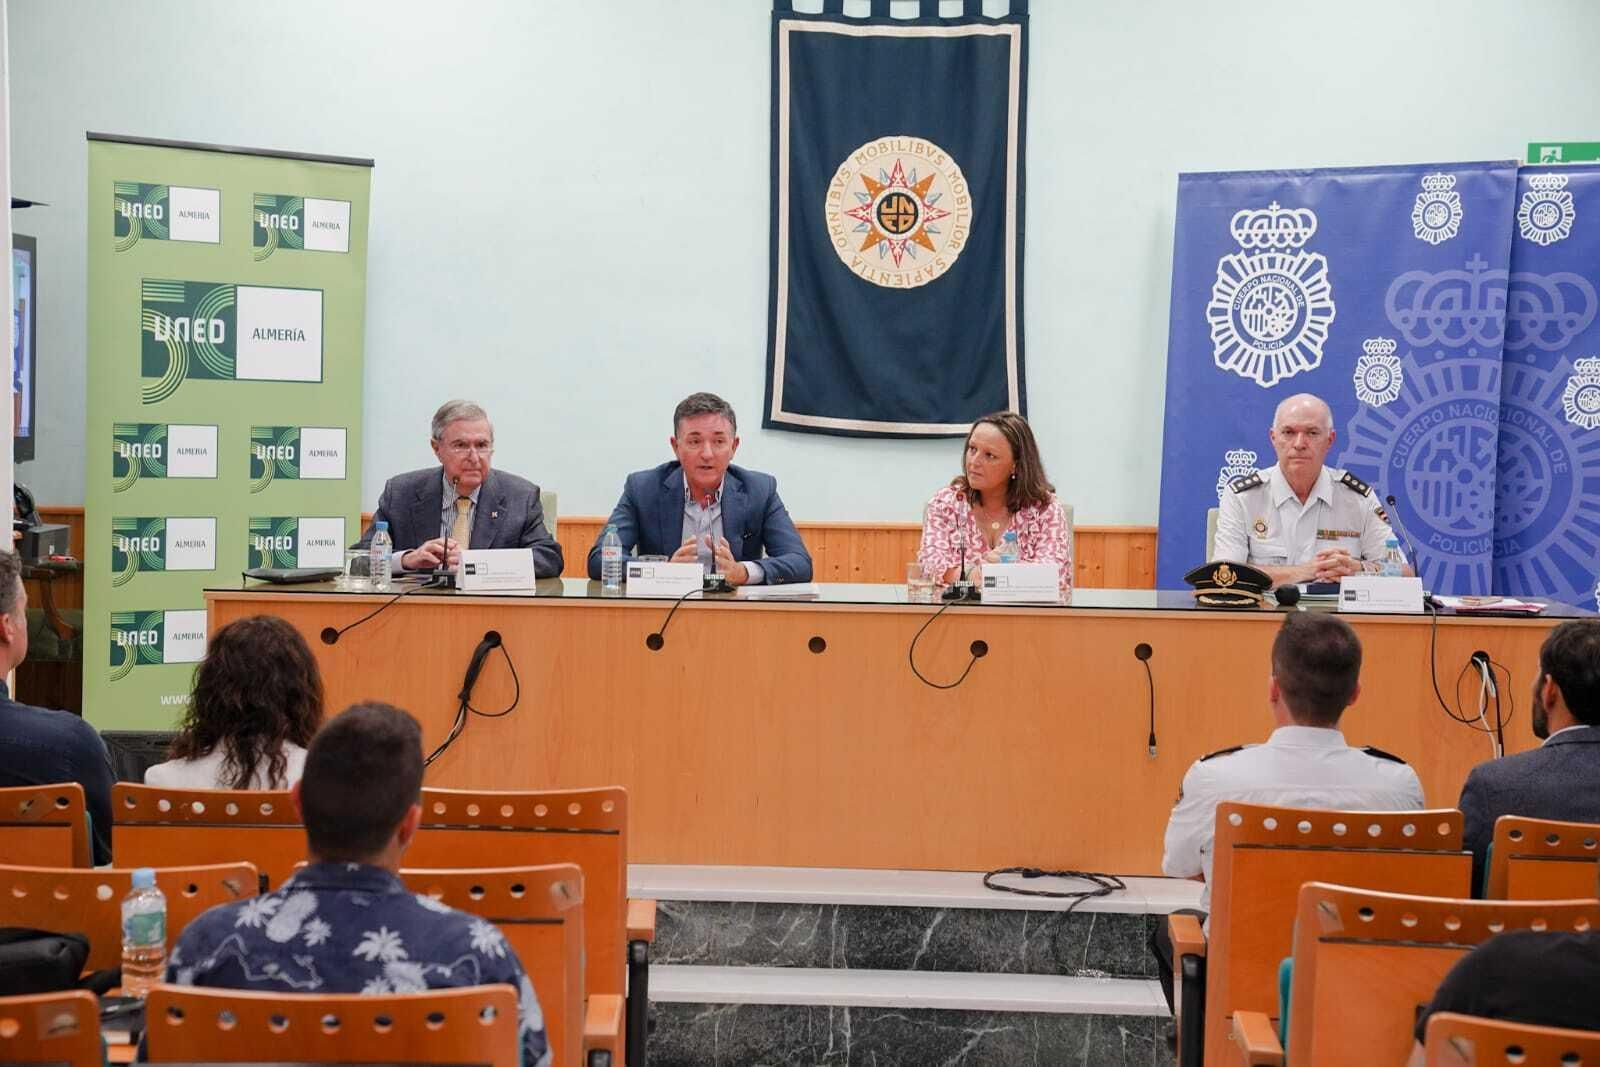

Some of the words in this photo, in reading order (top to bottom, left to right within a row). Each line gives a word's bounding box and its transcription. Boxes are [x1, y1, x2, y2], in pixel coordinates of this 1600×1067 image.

[855, 140, 946, 166] MOBILIBVS
[121, 202, 163, 219] UNED
[828, 166, 851, 248] OMNIBVS
[947, 170, 969, 249] MOBILIOR
[260, 213, 299, 230] UNED
[851, 255, 945, 286] SAPIENTIA
[1233, 277, 1259, 311] CUERPO
[1260, 275, 1298, 295] NACIONAL
[1295, 295, 1305, 307] DE
[154, 315, 225, 344] UNED
[252, 328, 306, 342] ALMERÍA
[1392, 409, 1444, 469] CUERPO
[1448, 403, 1498, 424] NACIO
[120, 443, 161, 458] UNED
[256, 445, 294, 460] UNED
[1550, 450, 1568, 474] DE
[119, 537, 160, 552] UNED
[255, 536, 292, 551] UNED
[117, 631, 158, 645] UNED
